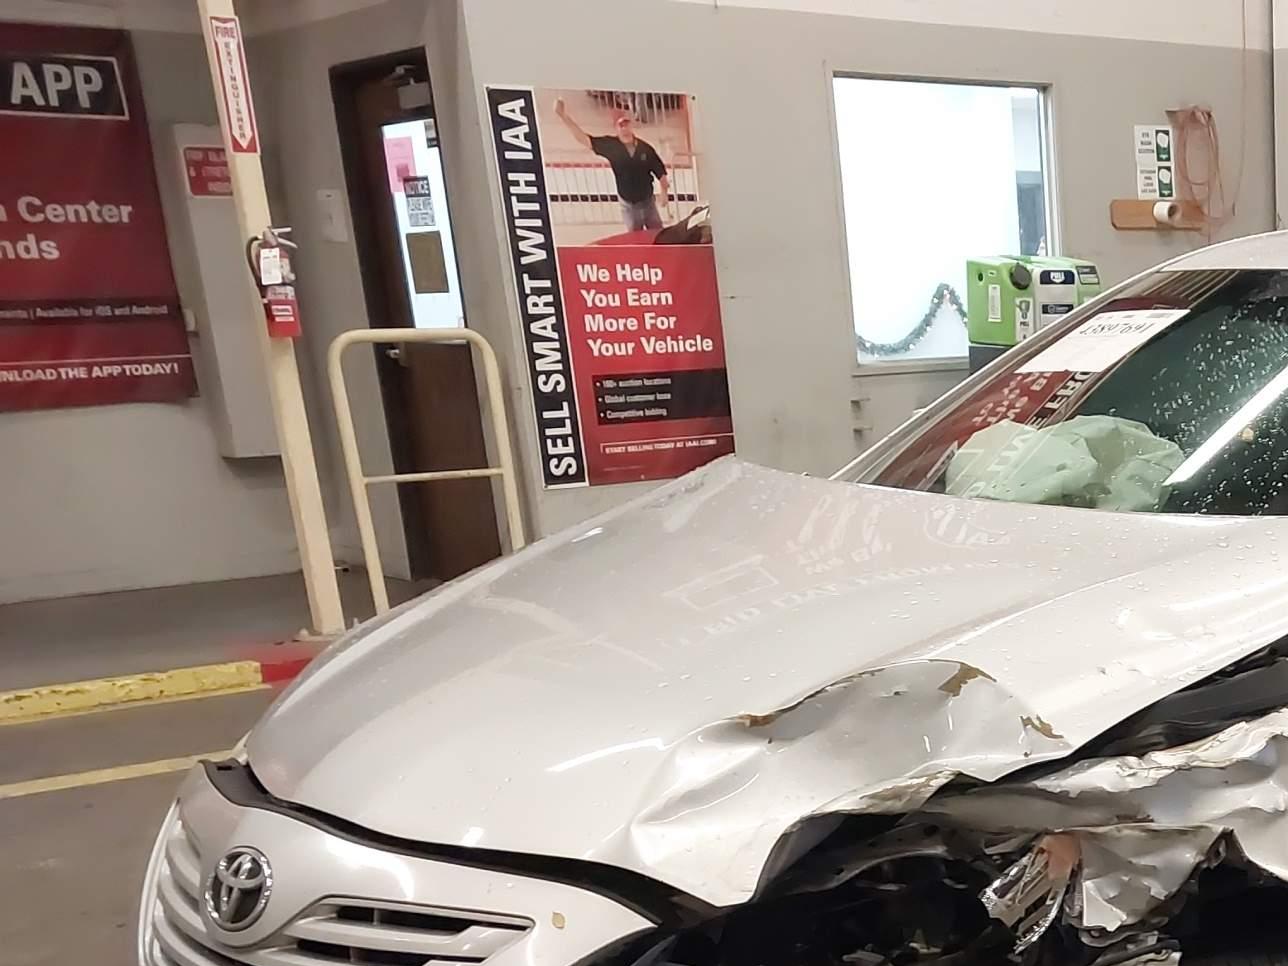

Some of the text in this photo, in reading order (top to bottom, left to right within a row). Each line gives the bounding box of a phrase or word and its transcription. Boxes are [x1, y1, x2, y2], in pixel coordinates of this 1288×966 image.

[215, 25, 236, 39] FIRE
[10, 61, 103, 108] APP
[17, 195, 133, 223] Center
[577, 263, 663, 284] We Help
[500, 97, 578, 477] SELL SMART WITH IAA
[580, 288, 673, 308] You Earn
[584, 313, 676, 333] More For
[587, 335, 713, 356] Your Vehicle
[0, 362, 179, 382] NLOAD THE APP TODAY!
